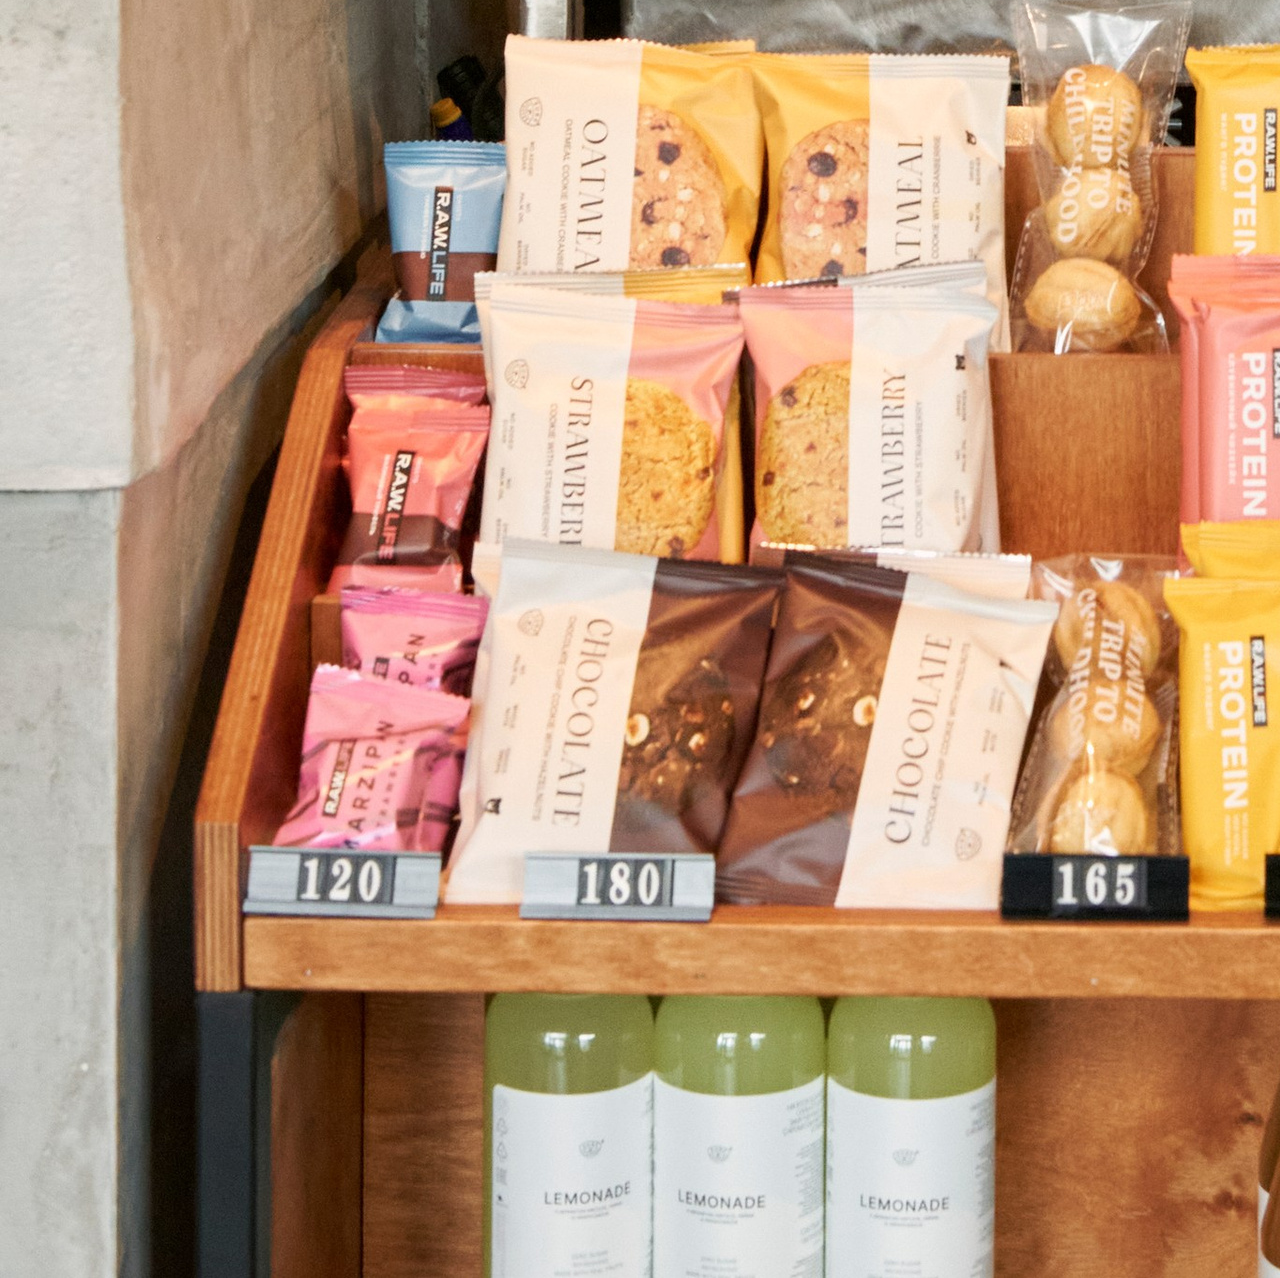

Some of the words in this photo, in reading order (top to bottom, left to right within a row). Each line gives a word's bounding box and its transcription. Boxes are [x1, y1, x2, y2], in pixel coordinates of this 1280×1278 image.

[1091, 96, 1114, 164] TRIP
[1115, 98, 1137, 215] MINUTE
[574, 118, 609, 272] OATMEA
[893, 135, 923, 268] ATMEAL
[931, 197, 940, 221] WITH
[1087, 169, 1111, 209] TO
[1232, 113, 1257, 256] PROTEIN
[930, 223, 940, 259] COOKIE
[548, 403, 558, 439] COOKIE
[914, 401, 923, 468] STRAWBERRY
[1241, 351, 1266, 517] PROTEIN
[545, 442, 555, 467] WITH
[880, 368, 907, 547] TRAWBERRY
[541, 469, 553, 538] STRAWBERRY
[914, 471, 924, 496] WITH
[914, 499, 924, 538] COOKIE
[1098, 619, 1125, 681] TRIP
[1092, 684, 1119, 723] TO
[1123, 625, 1148, 740] MINUTE
[551, 618, 614, 827] CHOCOLATE
[884, 633, 953, 844] CHOCOLATE
[1218, 640, 1249, 810] PROTEIN
[300, 858, 382, 902] 120
[581, 862, 661, 906] 180
[1056, 862, 1135, 905] 165
[544, 1182, 631, 1206] LEMONADE
[678, 1189, 766, 1209] LEMONADE
[860, 1193, 950, 1212] LEMONADE
